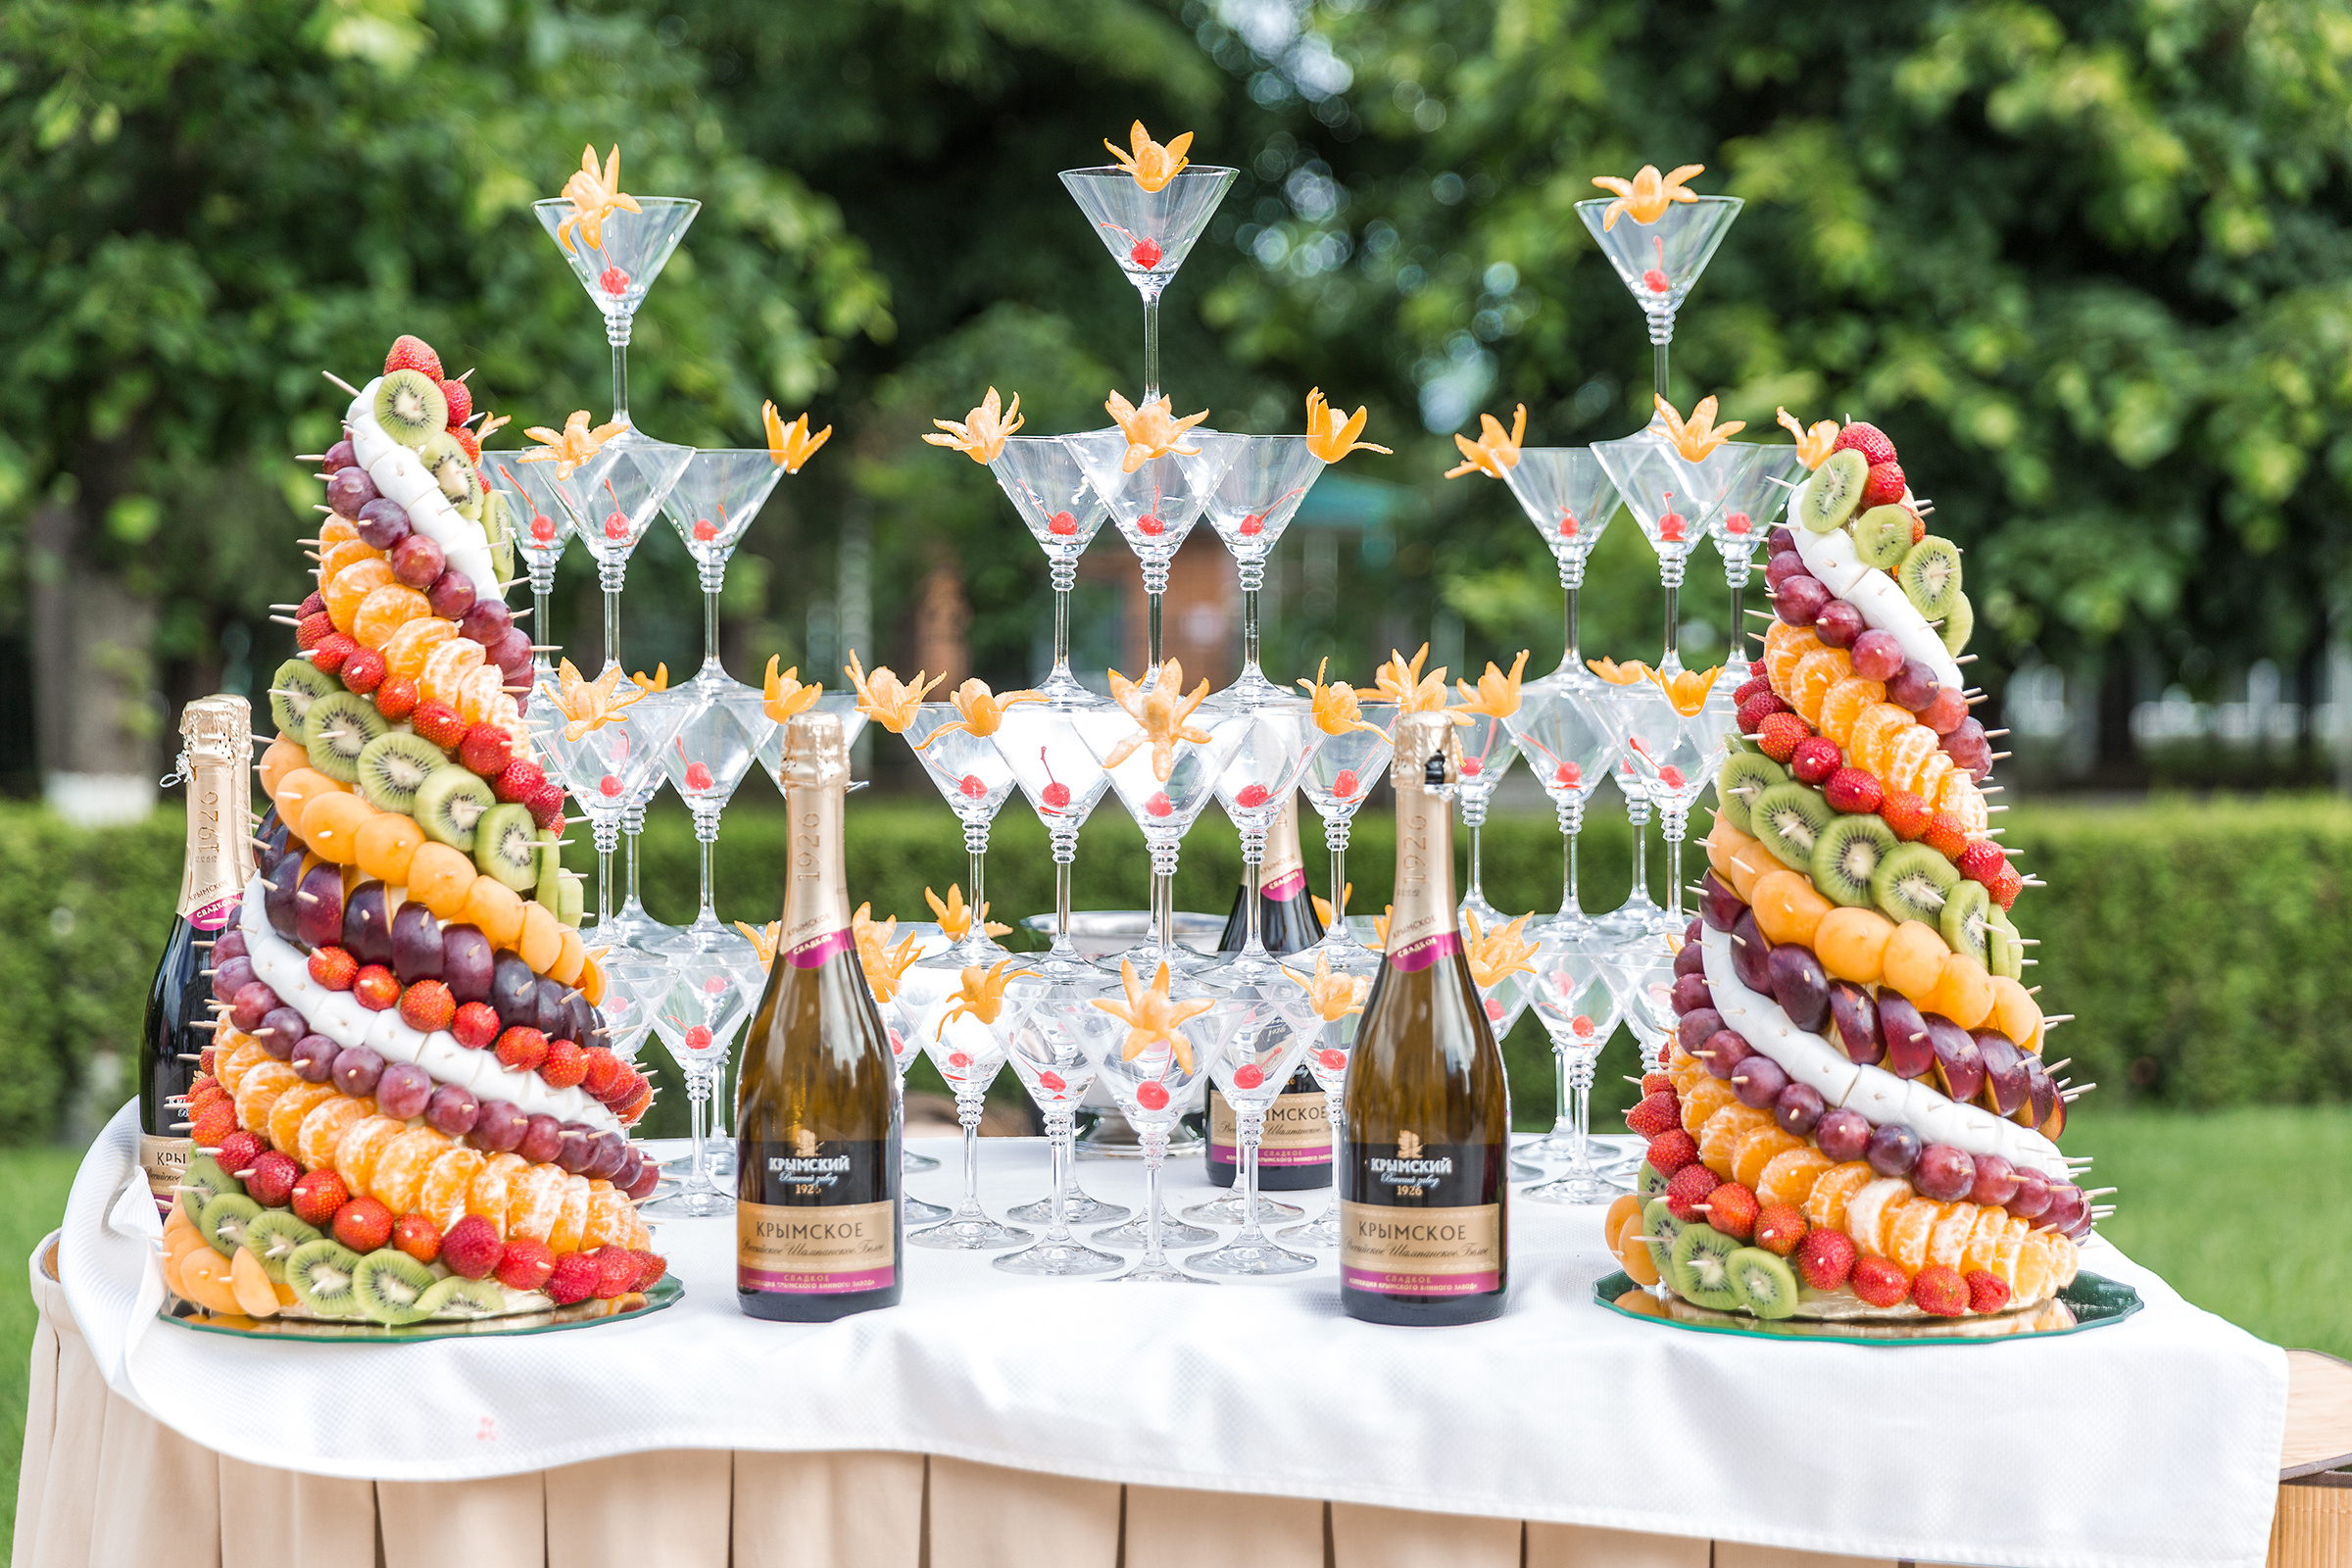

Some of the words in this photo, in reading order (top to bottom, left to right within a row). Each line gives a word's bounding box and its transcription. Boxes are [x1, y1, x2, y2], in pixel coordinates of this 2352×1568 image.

[197, 790, 220, 854] 1926
[797, 812, 820, 882] 1926
[1403, 814, 1427, 884] 1926
[1393, 914, 1437, 939] КРЫМСКОЕ
[1266, 1106, 1326, 1121] МСКОЕ
[768, 1155, 851, 1171] КРЫМСКИЙ
[1370, 1157, 1452, 1173] КРЫМСКИЙ
[1396, 1185, 1423, 1196] 1926
[757, 1221, 863, 1240] КРЫМСКОЕ
[1358, 1221, 1466, 1241] КРЫМСКОЕ
[1386, 1275, 1431, 1284] СЛАДКОЕ
